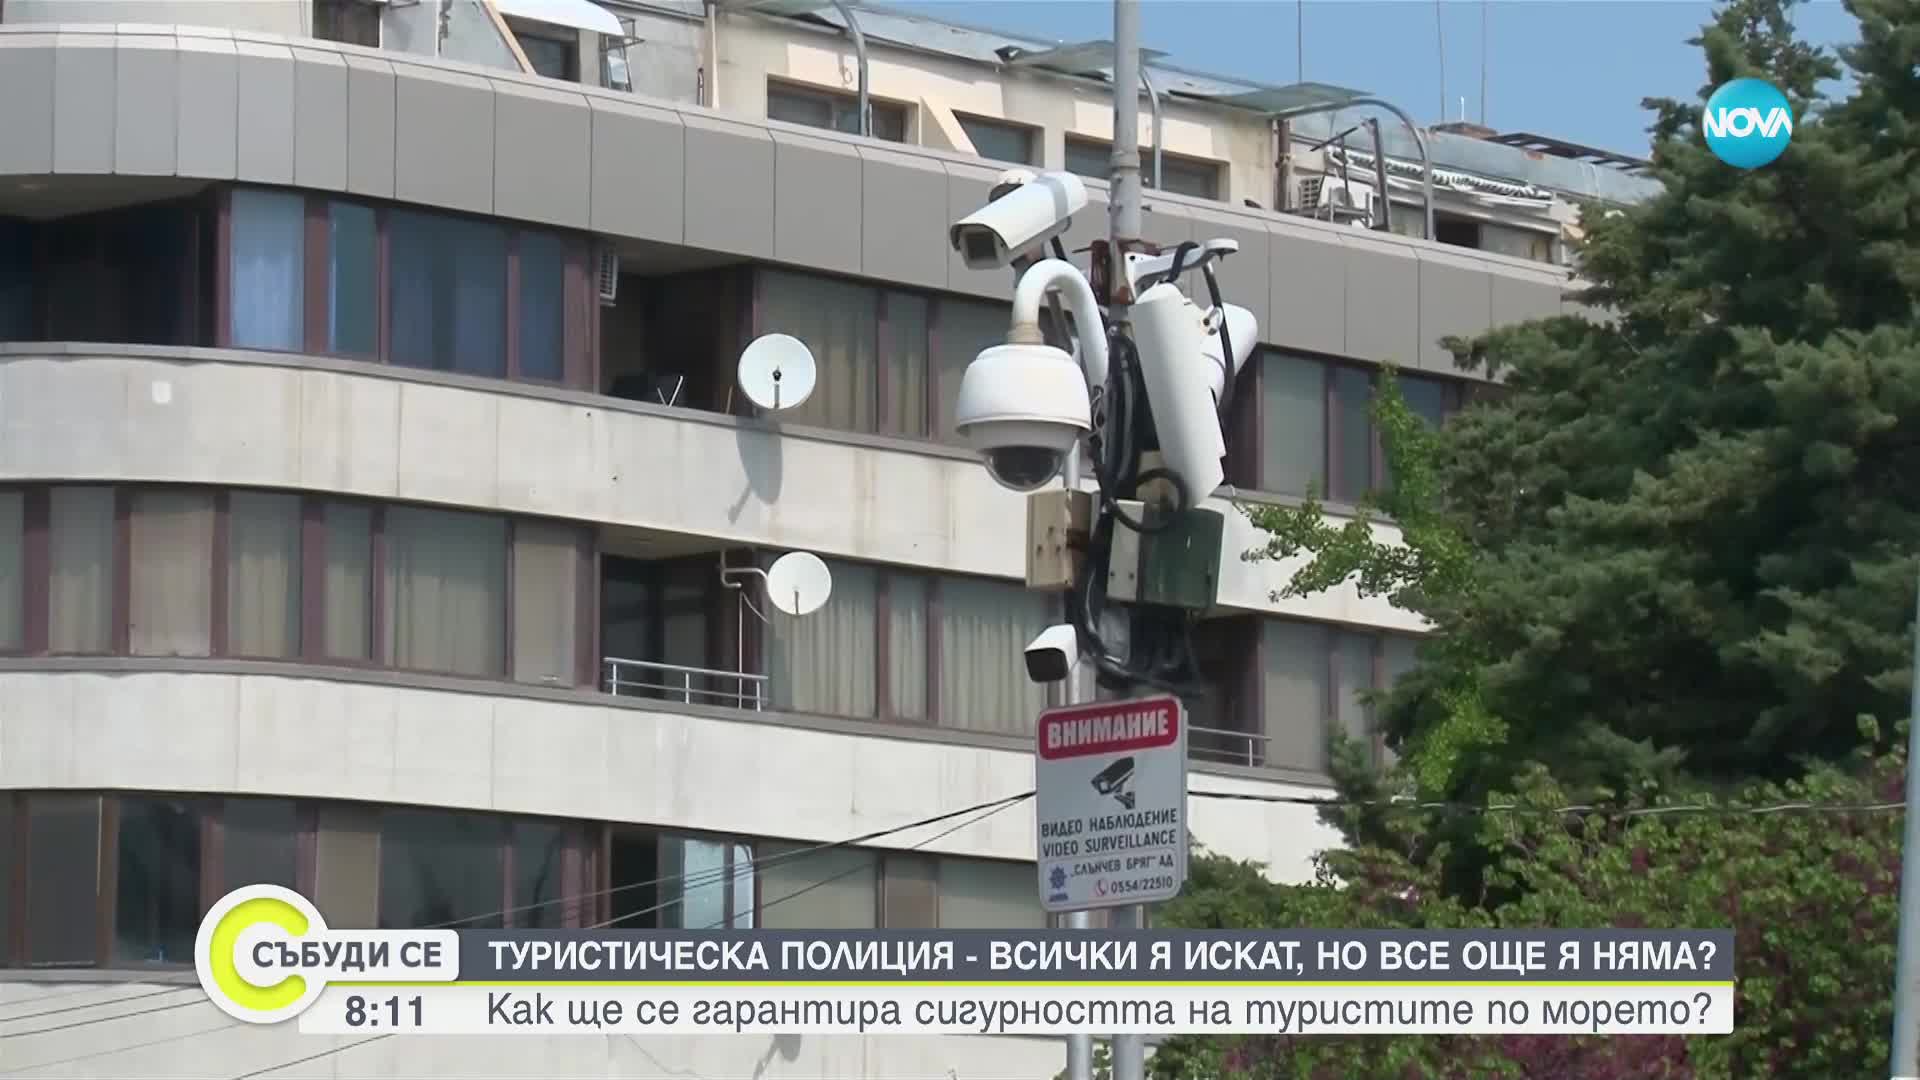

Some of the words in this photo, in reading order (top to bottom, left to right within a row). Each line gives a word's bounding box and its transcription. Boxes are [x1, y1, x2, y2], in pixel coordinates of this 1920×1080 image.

[1047, 708, 1169, 750] ВНИМАНИЕ
[1041, 819, 1083, 838] ВИДЕО
[1089, 808, 1177, 832] НАБЛЮДЕНИЕ
[1043, 839, 1079, 857] VIDEO
[1085, 829, 1177, 853] SURVEILLANCE
[1159, 854, 1174, 868] АД
[1111, 876, 1173, 895] 0554/22510
